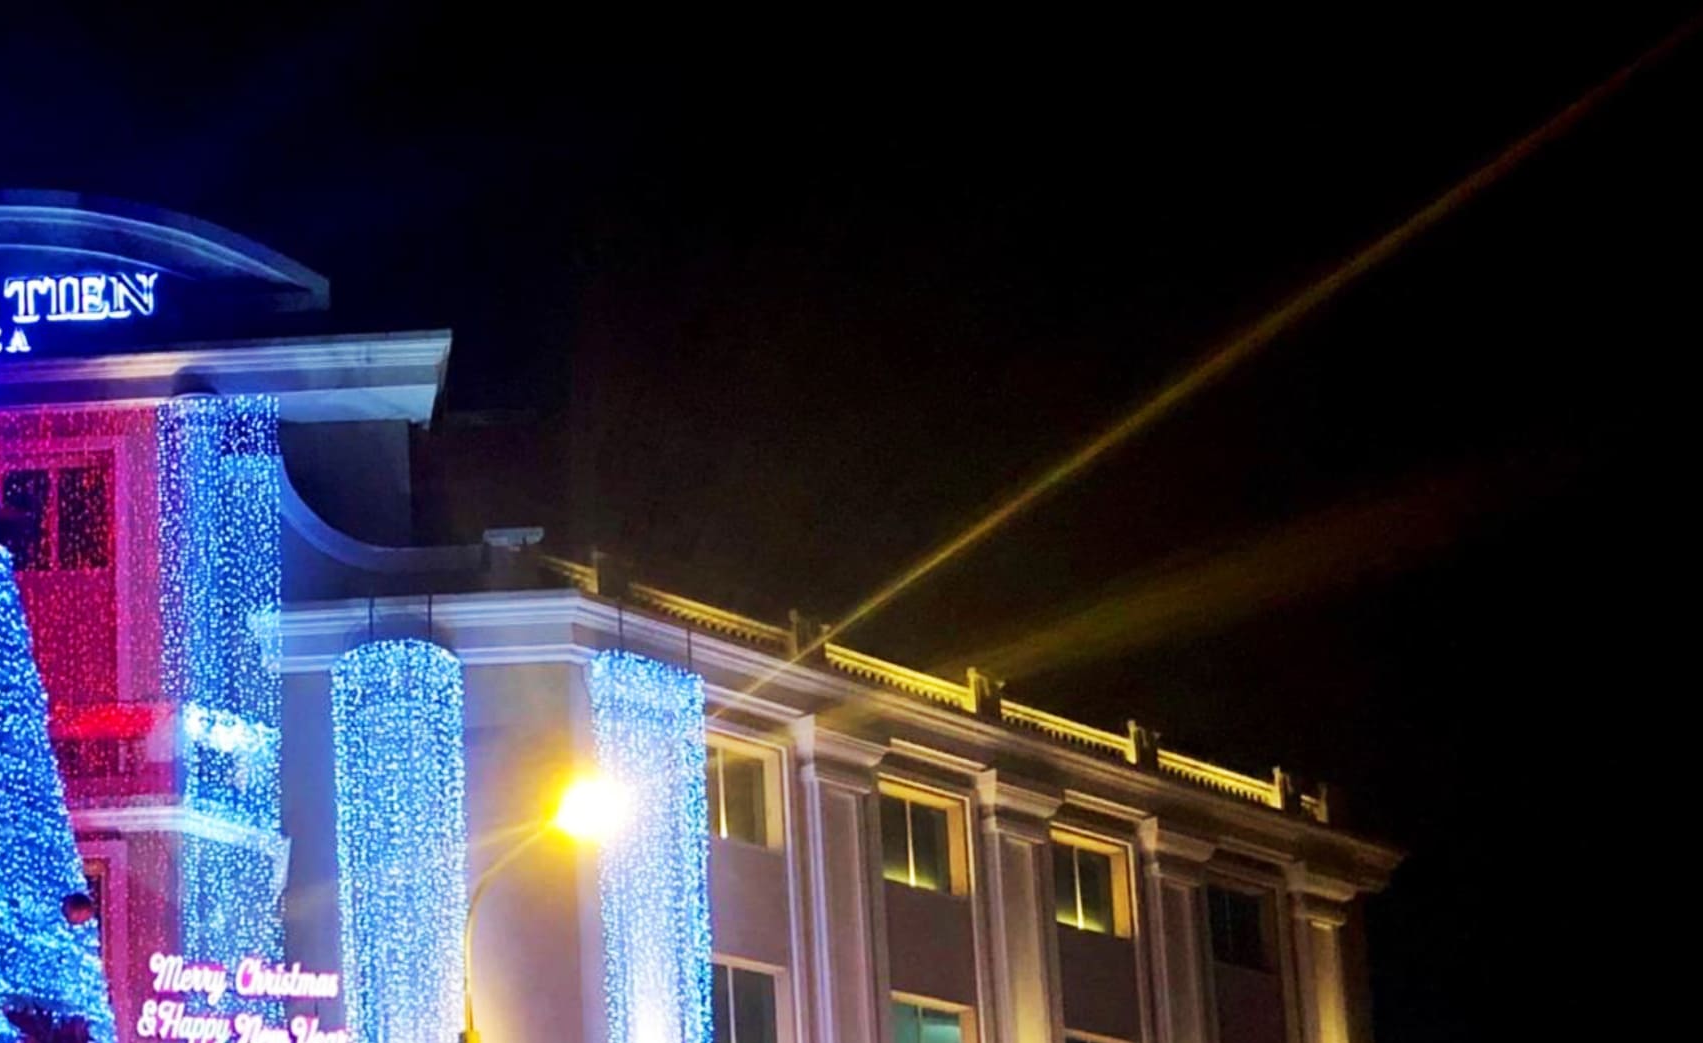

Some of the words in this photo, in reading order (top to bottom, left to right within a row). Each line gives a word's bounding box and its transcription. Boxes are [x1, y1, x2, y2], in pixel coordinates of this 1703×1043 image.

[3, 272, 159, 326] TIEN
[149, 952, 227, 1005] Merry
[234, 956, 339, 998] Christmas
